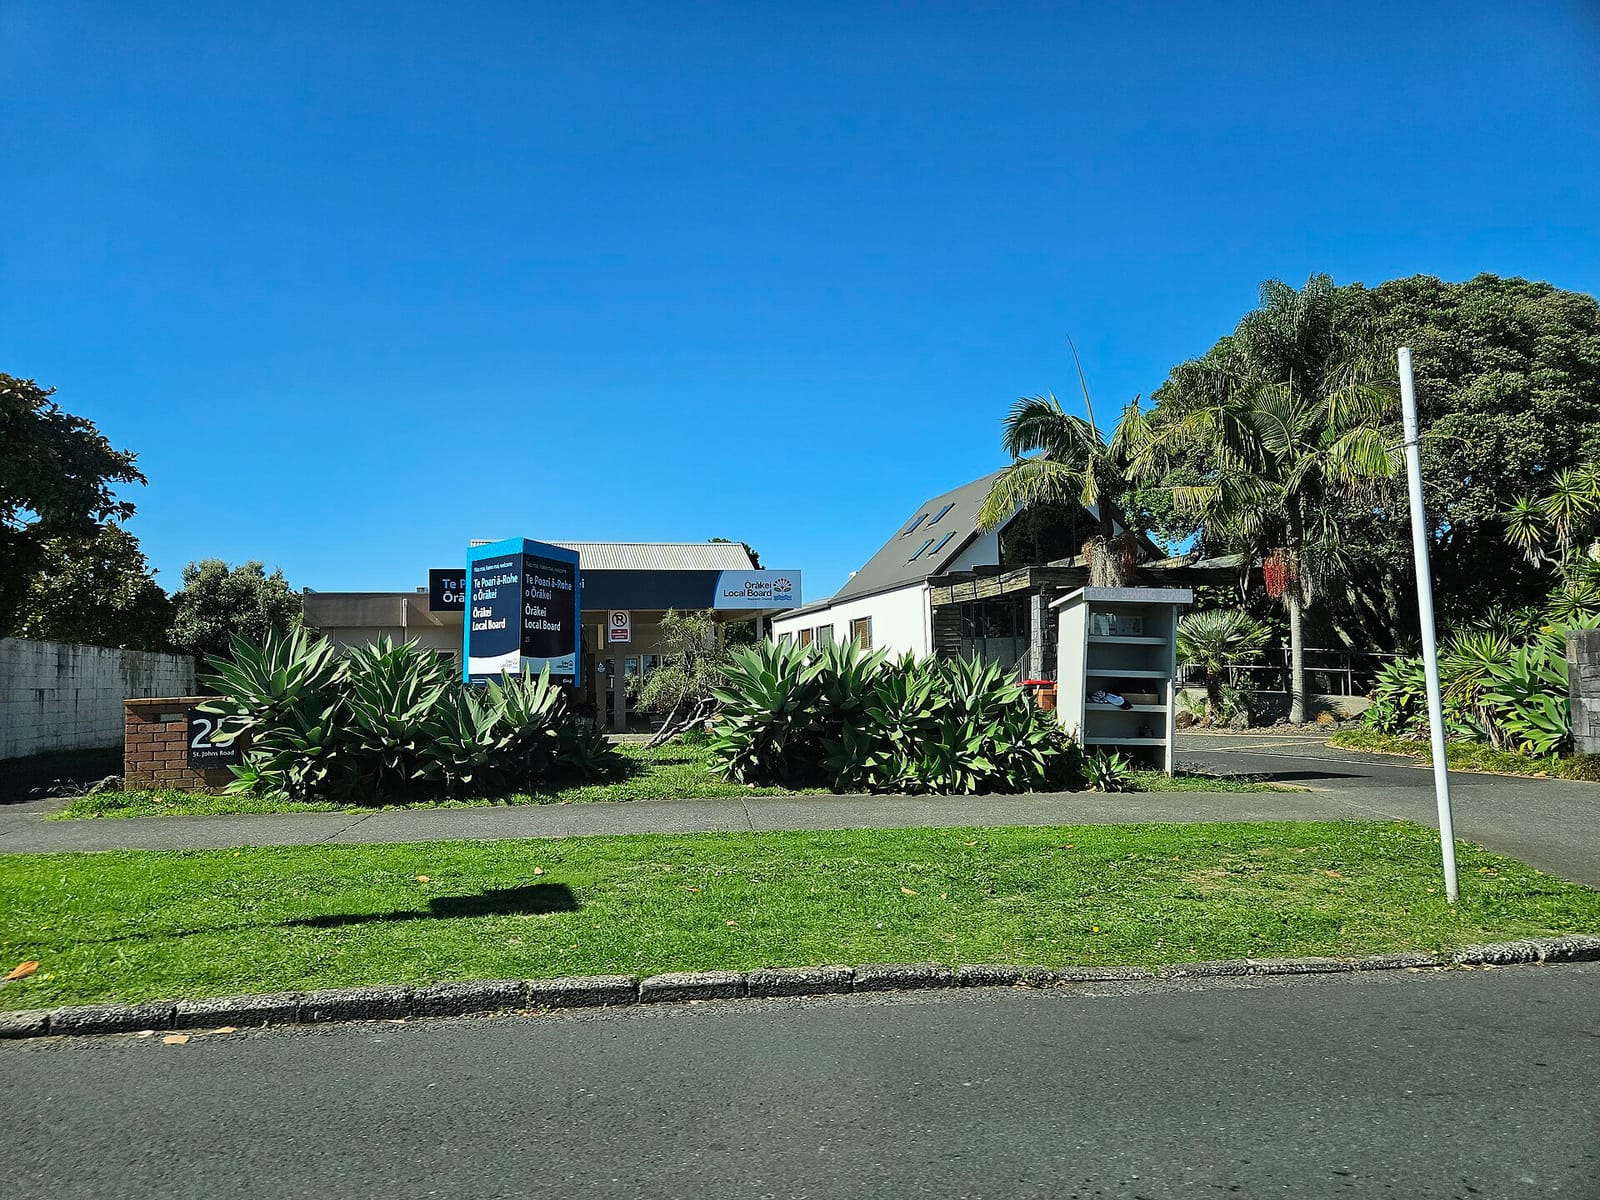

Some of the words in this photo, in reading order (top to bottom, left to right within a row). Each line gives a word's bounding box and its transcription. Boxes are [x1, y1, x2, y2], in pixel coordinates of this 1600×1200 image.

[442, 579, 456, 589] Te
[473, 578, 481, 588] Te
[481, 576, 496, 588] Poari
[525, 573, 534, 585] Te
[534, 575, 550, 587] Poari
[442, 590, 465, 603] Ōrā
[723, 589, 746, 597] Local
[747, 589, 772, 597] Board
[1089, 588, 1117, 599] FOOD
[472, 619, 488, 631] Local
[488, 618, 506, 630] Board
[524, 618, 542, 630] Local
[542, 620, 561, 632] Board
